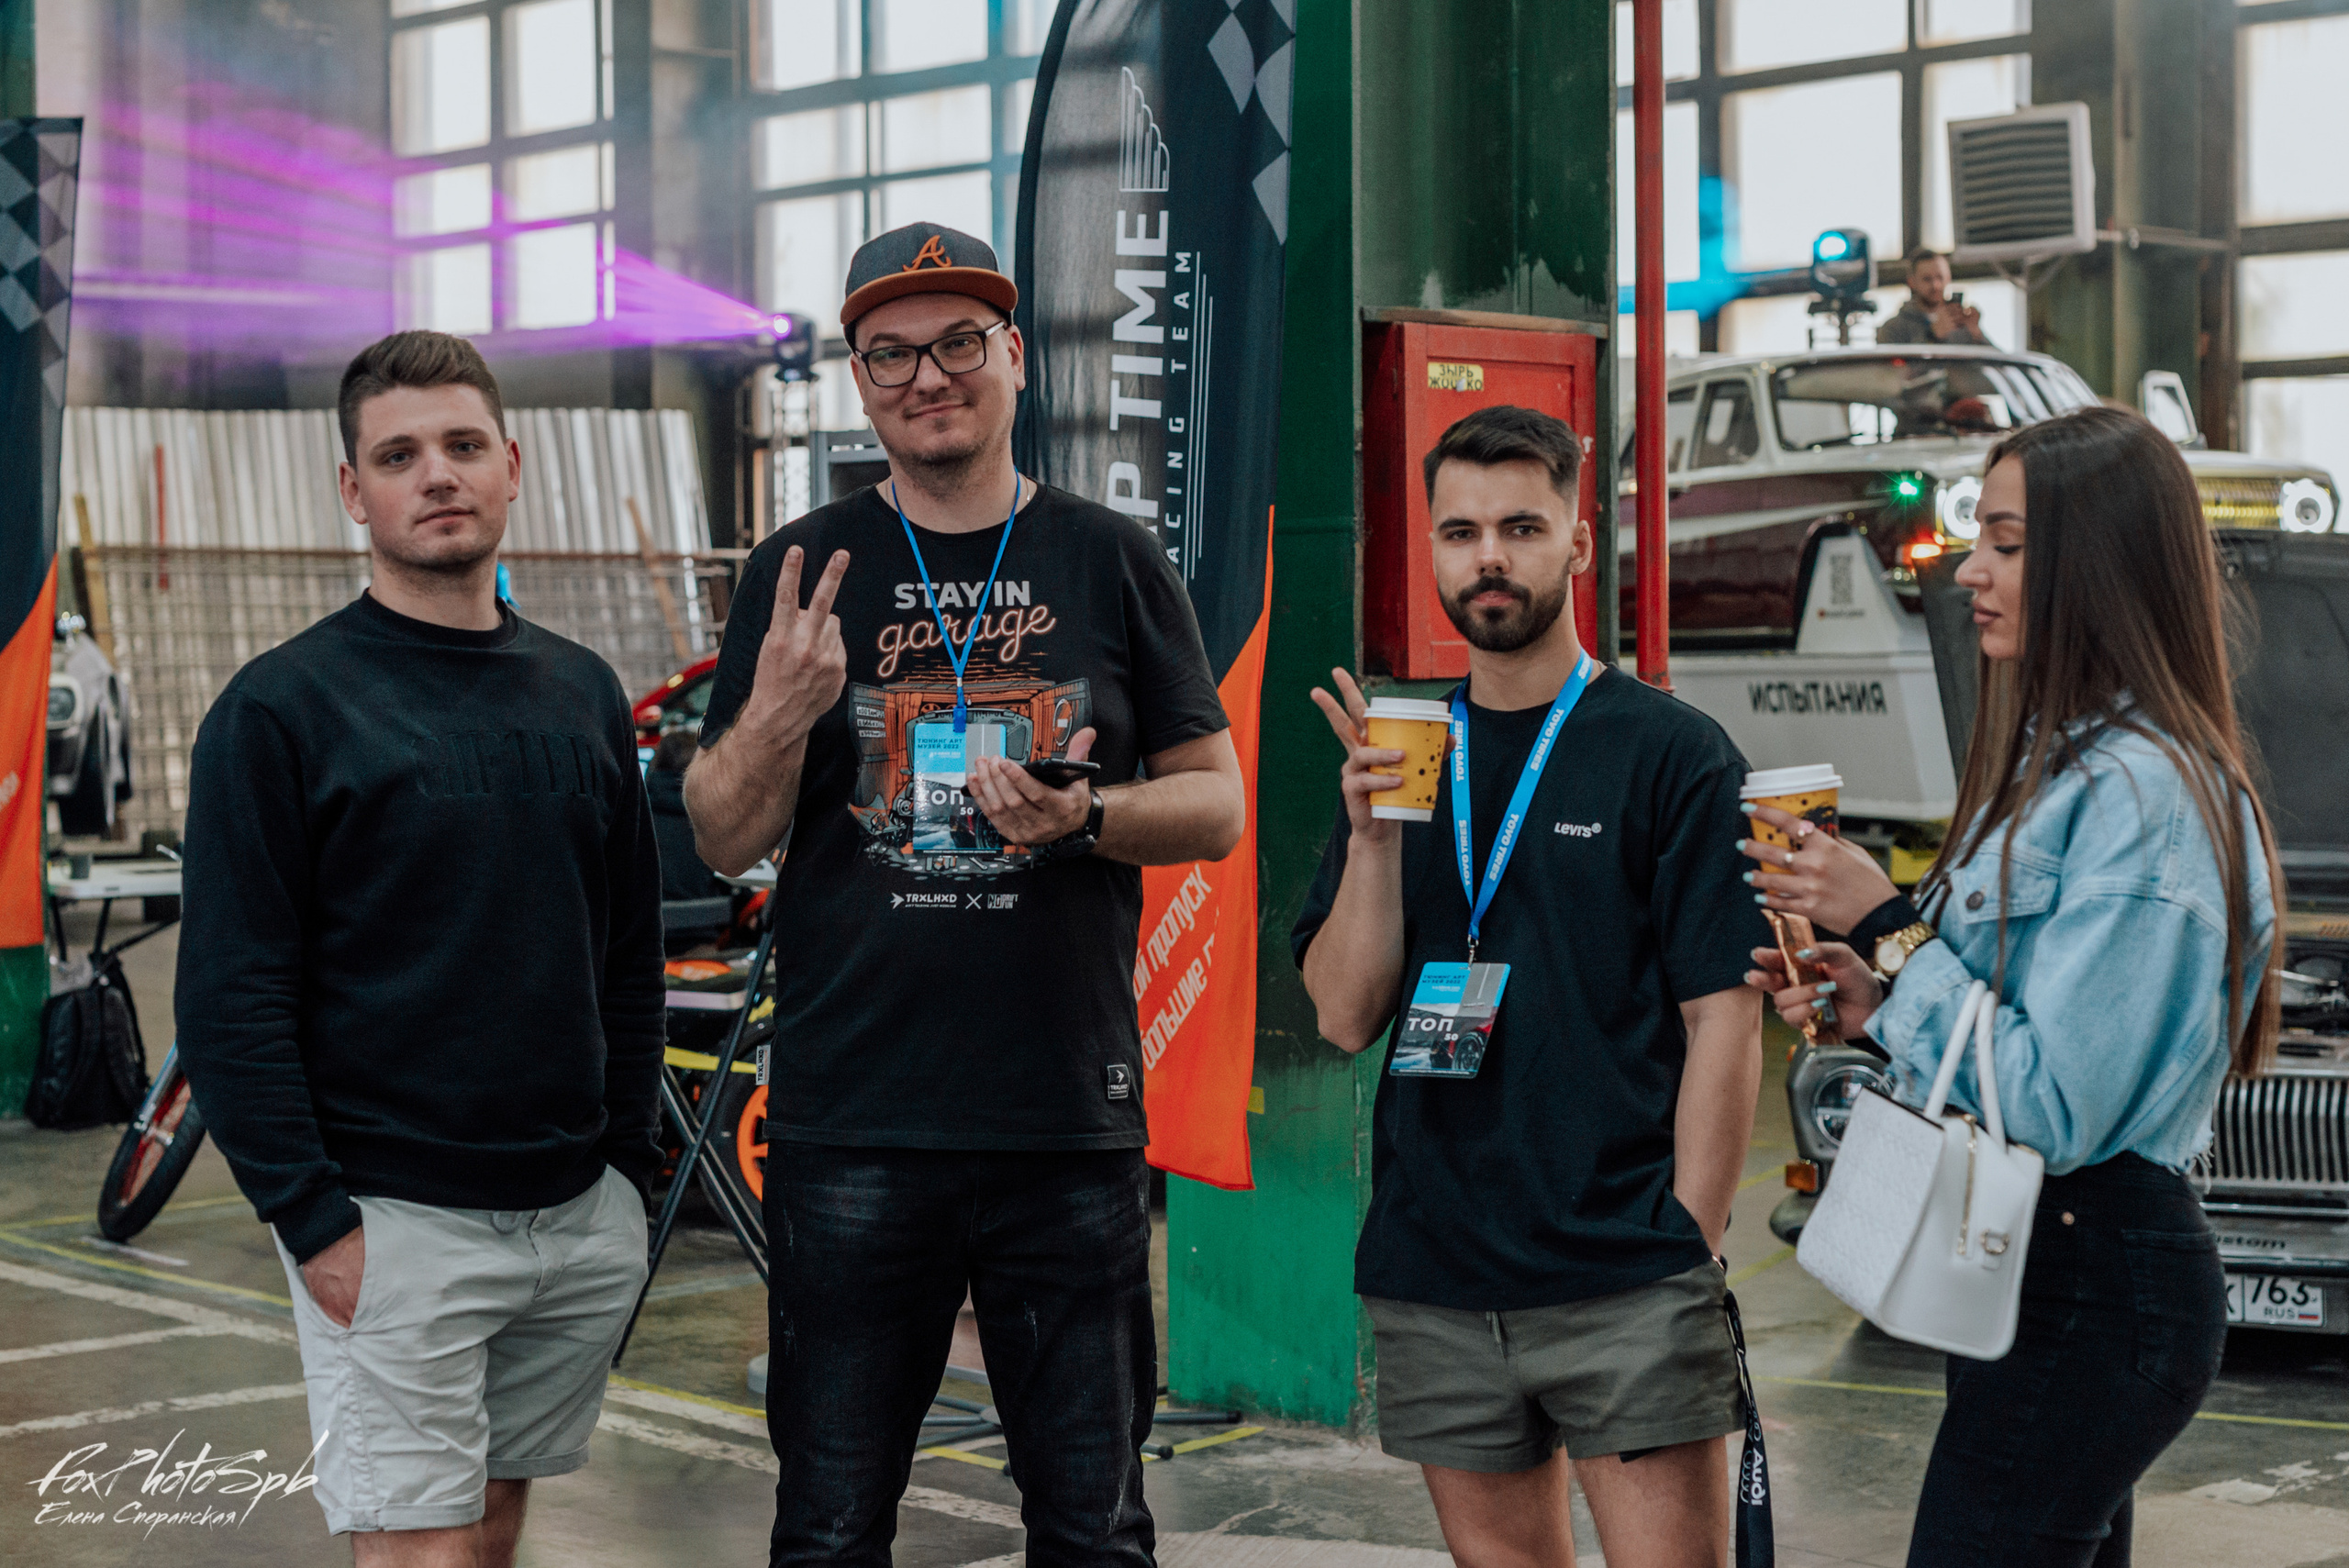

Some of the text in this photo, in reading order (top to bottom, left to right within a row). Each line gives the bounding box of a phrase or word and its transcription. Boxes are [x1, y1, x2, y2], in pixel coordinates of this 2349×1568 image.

[1108, 209, 1169, 431] TIME
[1171, 251, 1192, 373] TEAM
[894, 580, 1030, 609] STAY IN
[877, 605, 1056, 677] garage
[1747, 681, 1888, 716] ИСПЫТАНИЯ
[1454, 720, 1464, 751] TIRES
[1530, 736, 1551, 772] TIRES
[960, 806, 974, 816] 50
[1458, 819, 1468, 854] TIRES
[1488, 842, 1508, 882] TIRES
[905, 893, 958, 904] TRXLHXD
[1146, 863, 1212, 973] пропуск
[1408, 1018, 1454, 1032] ТОП
[1443, 1033, 1459, 1041] 50
[2264, 1307, 2295, 1318] RUS
[1750, 1447, 1766, 1506] Audi
